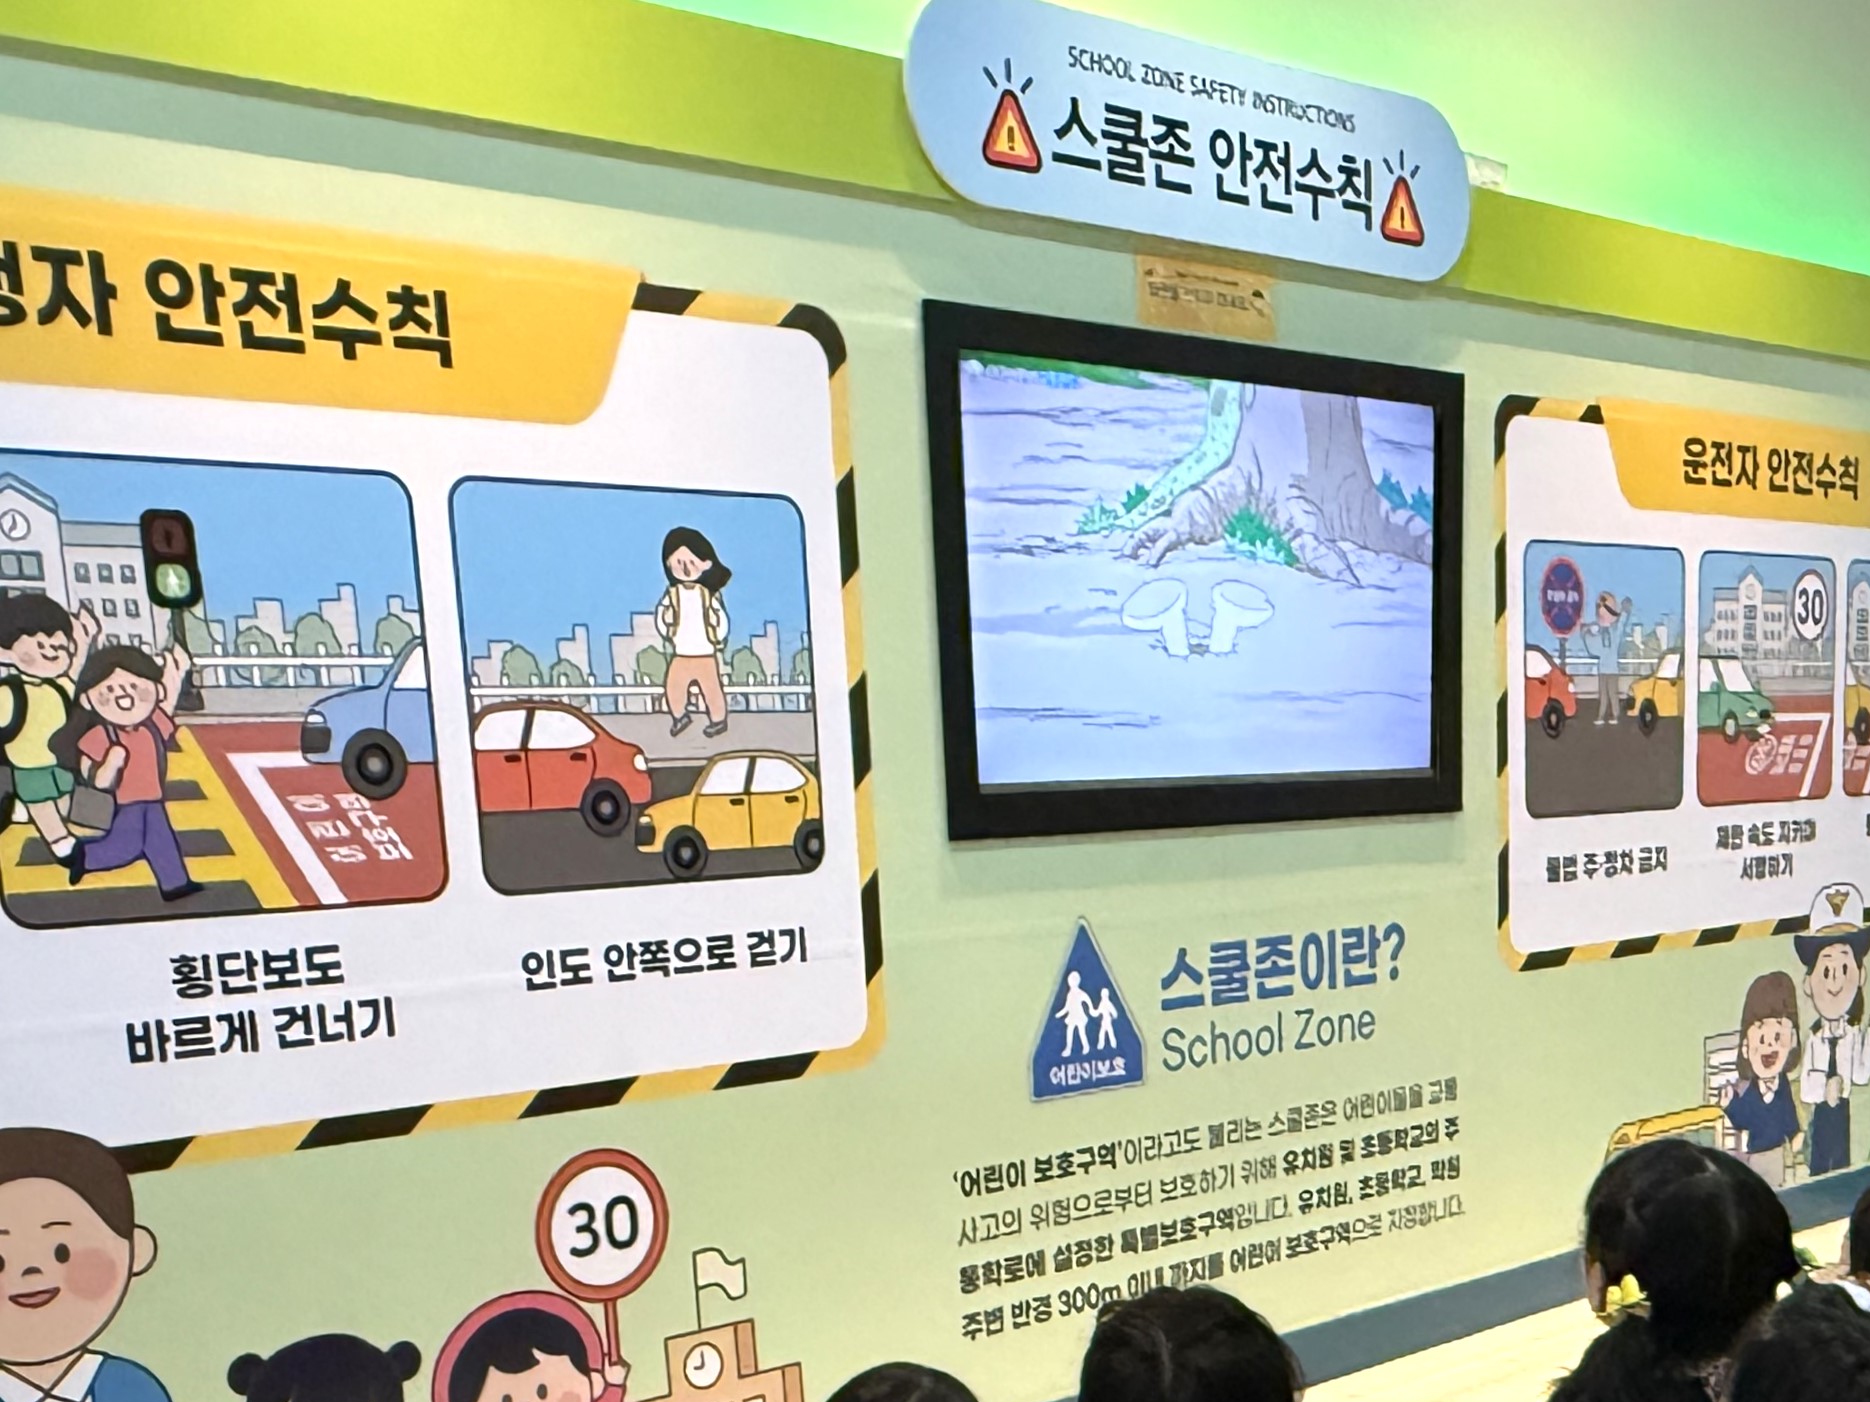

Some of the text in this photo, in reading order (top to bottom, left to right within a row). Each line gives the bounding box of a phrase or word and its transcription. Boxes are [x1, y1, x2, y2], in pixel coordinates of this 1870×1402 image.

[1068, 46, 1356, 134] SCHOOL ZONE SAFETY INSTRUCTIONS
[1052, 96, 1373, 231] 스쿨존 안전수칙
[145, 258, 454, 369] 안전수칙
[1683, 437, 1859, 501] 운전자 안전수칙
[1798, 587, 1824, 625] 30
[169, 943, 345, 999] 횡단보도
[520, 926, 808, 991] 인도 안쪽으로 걷기
[1161, 922, 1406, 1011] 스쿨존이란?
[126, 996, 397, 1064] 바르게 건너기
[1162, 1008, 1376, 1071] School Zone
[1050, 1056, 1126, 1086] 어린이보호
[1268, 1100, 1338, 1136] 스쿨존은
[567, 1193, 640, 1258] 30
[957, 1207, 1022, 1246] 사고의
[1030, 1180, 1152, 1231] 위험으로부터
[1160, 1162, 1234, 1203] 보호하기
[1241, 1154, 1277, 1184] 위해
[1283, 1142, 1334, 1176] 유치원
[959, 1249, 1046, 1294] 통학로에
[1054, 1234, 1115, 1272] 설정한
[962, 1305, 1004, 1340] 주변
[1012, 1294, 1052, 1329] 반경
[1058, 1283, 1122, 1317] 300m
[1229, 1236, 1281, 1273] 어린이
[1285, 1212, 1382, 1259] 보호구역으로
